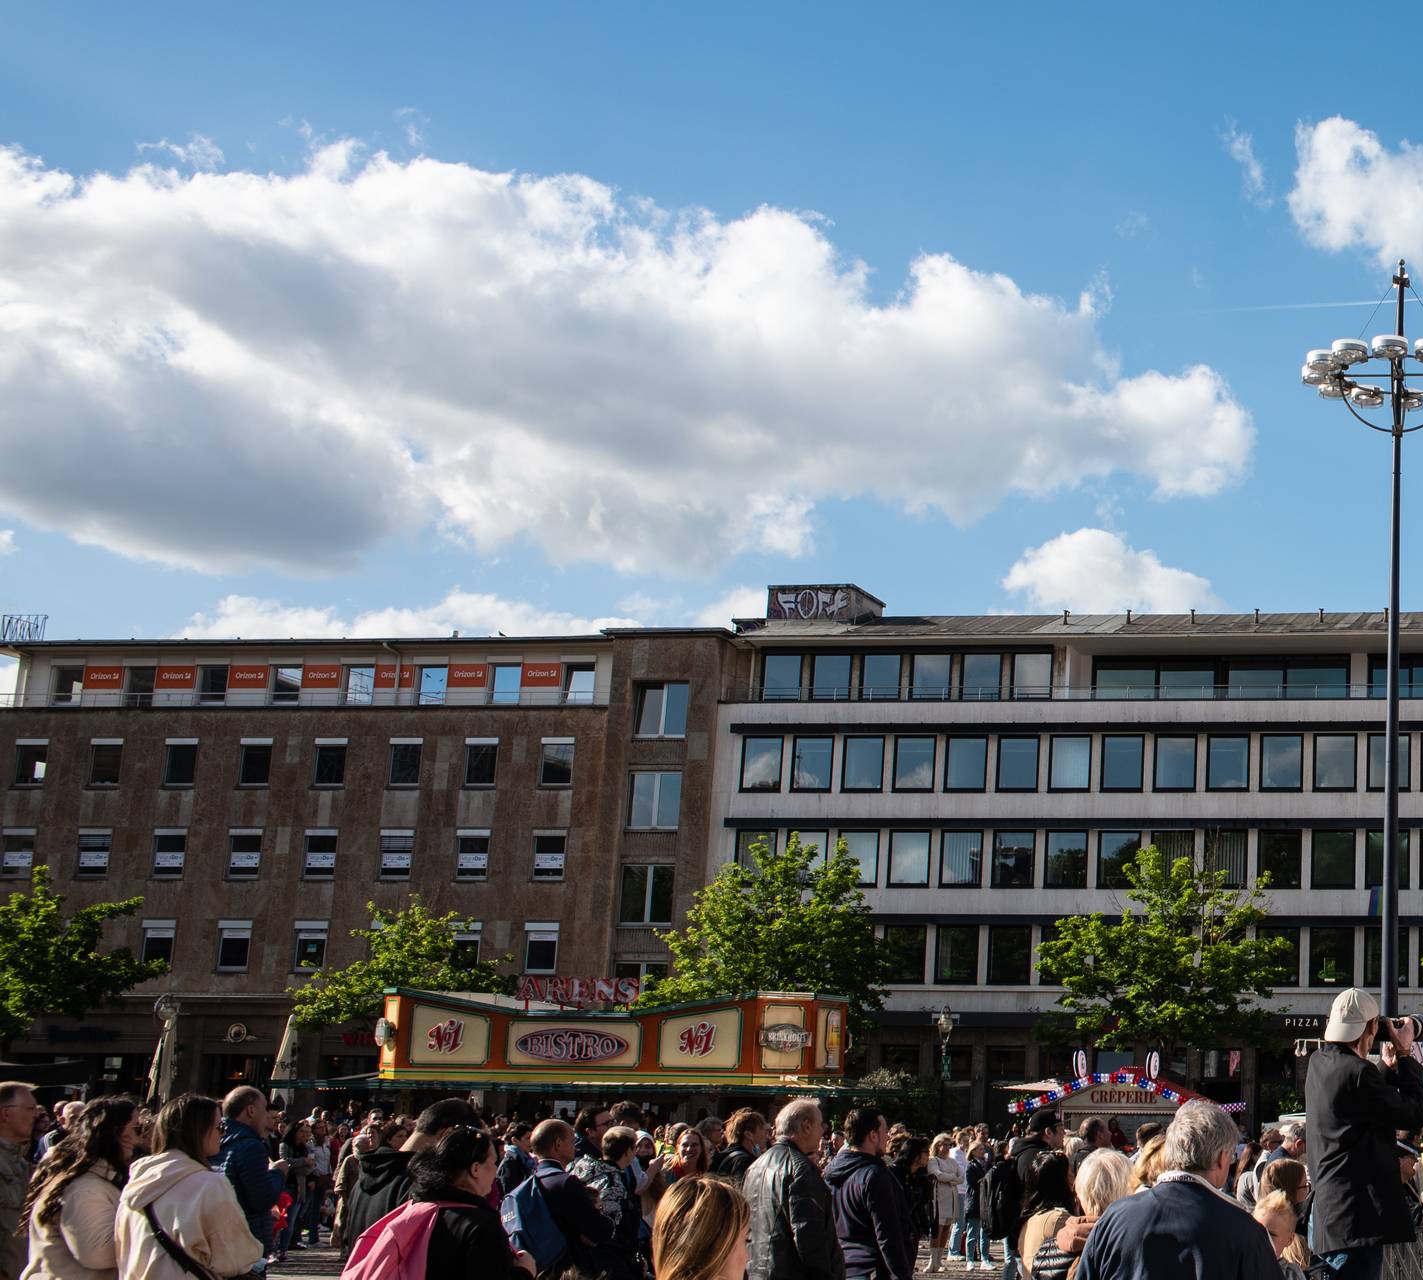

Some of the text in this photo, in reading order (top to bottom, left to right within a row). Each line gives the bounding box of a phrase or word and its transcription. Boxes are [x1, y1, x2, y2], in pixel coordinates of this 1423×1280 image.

[90, 672, 112, 680] Orizon
[162, 672, 184, 680] Orizon
[308, 671, 330, 679] Orizon
[527, 670, 549, 678] Orizon
[515, 975, 640, 1002] ARENS
[1285, 1018, 1319, 1027] PIZZA
[526, 1031, 620, 1060] BISTRO
[1090, 1088, 1158, 1105] CRÊPERIE
